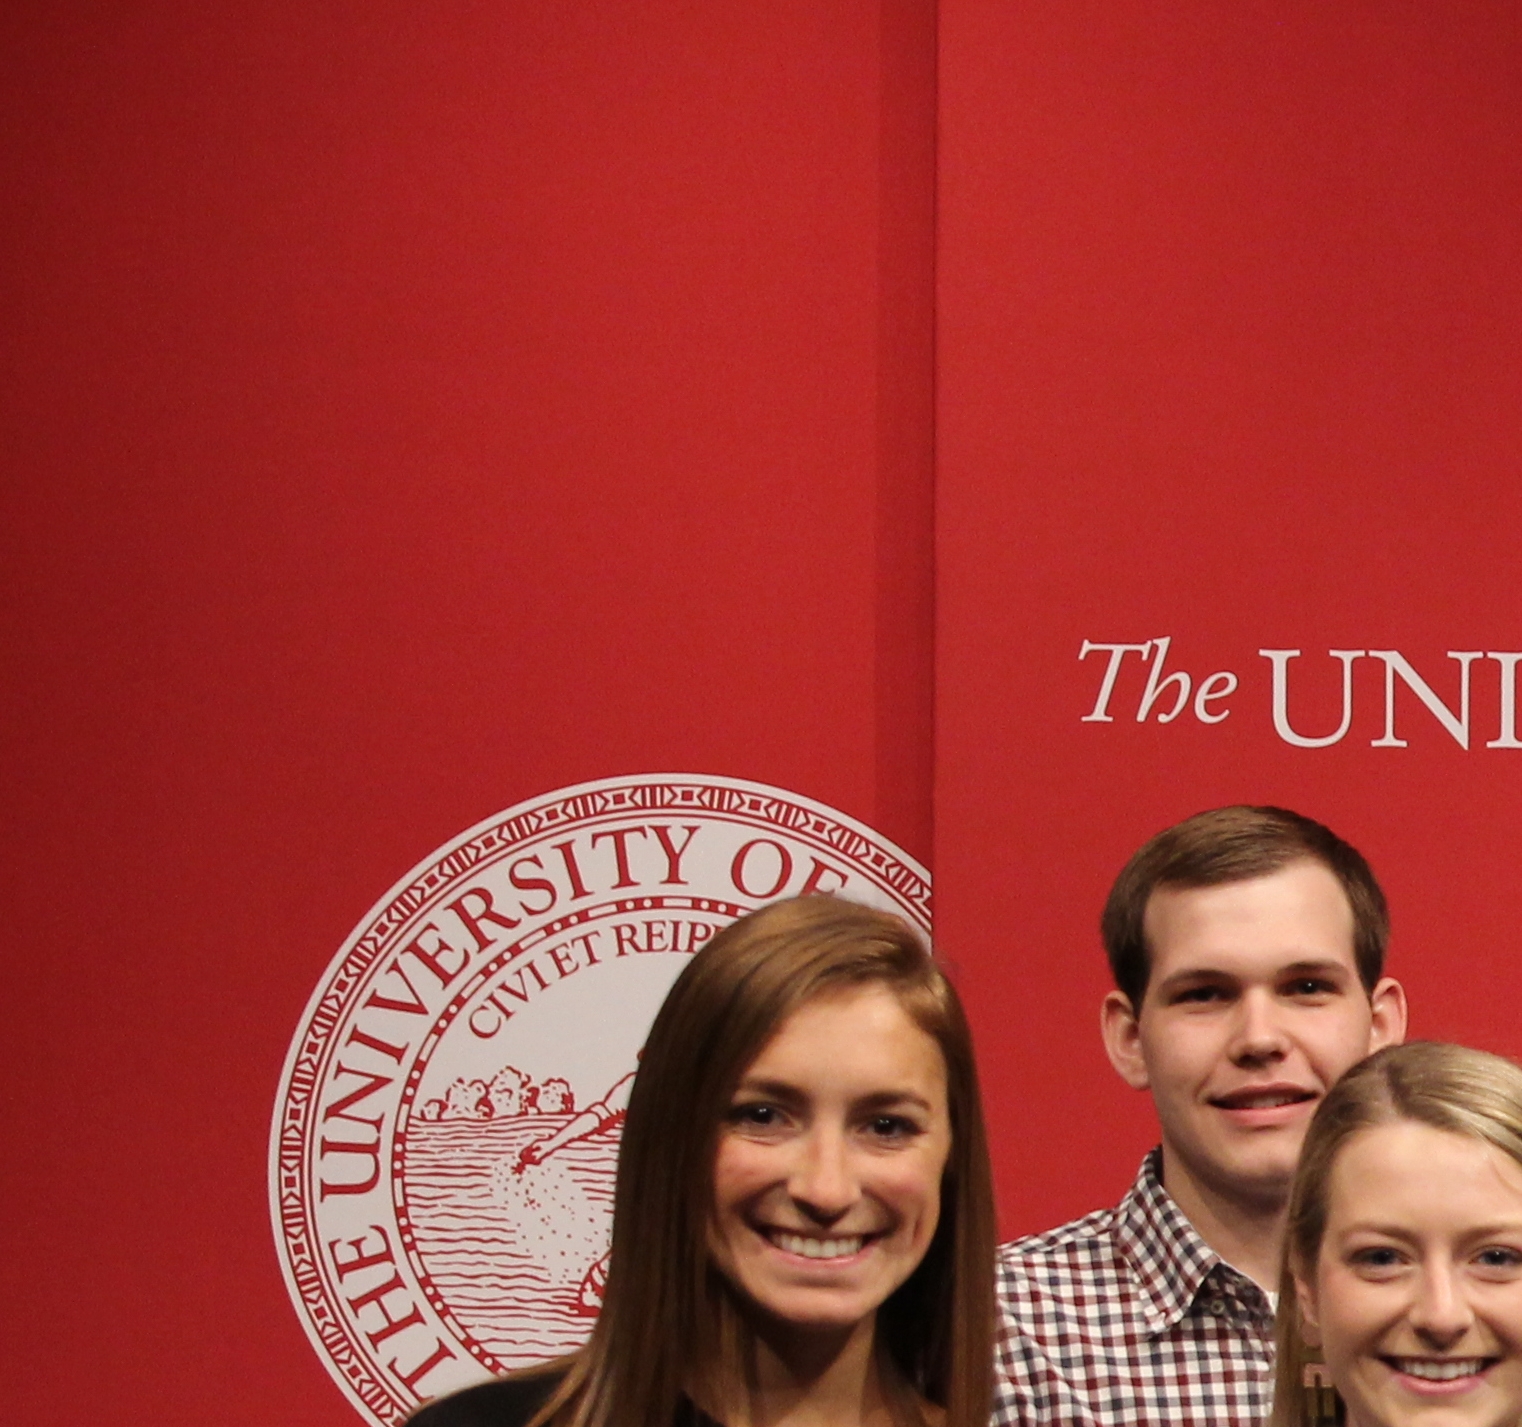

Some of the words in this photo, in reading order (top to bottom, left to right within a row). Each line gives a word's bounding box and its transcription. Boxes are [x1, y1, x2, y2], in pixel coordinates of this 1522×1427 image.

[1078, 636, 1238, 724] The
[321, 825, 701, 1202] UNIVERSITY
[468, 952, 551, 1040] CIVI
[553, 931, 601, 981] ET
[611, 919, 722, 958] REIP
[332, 1224, 459, 1402] THE
